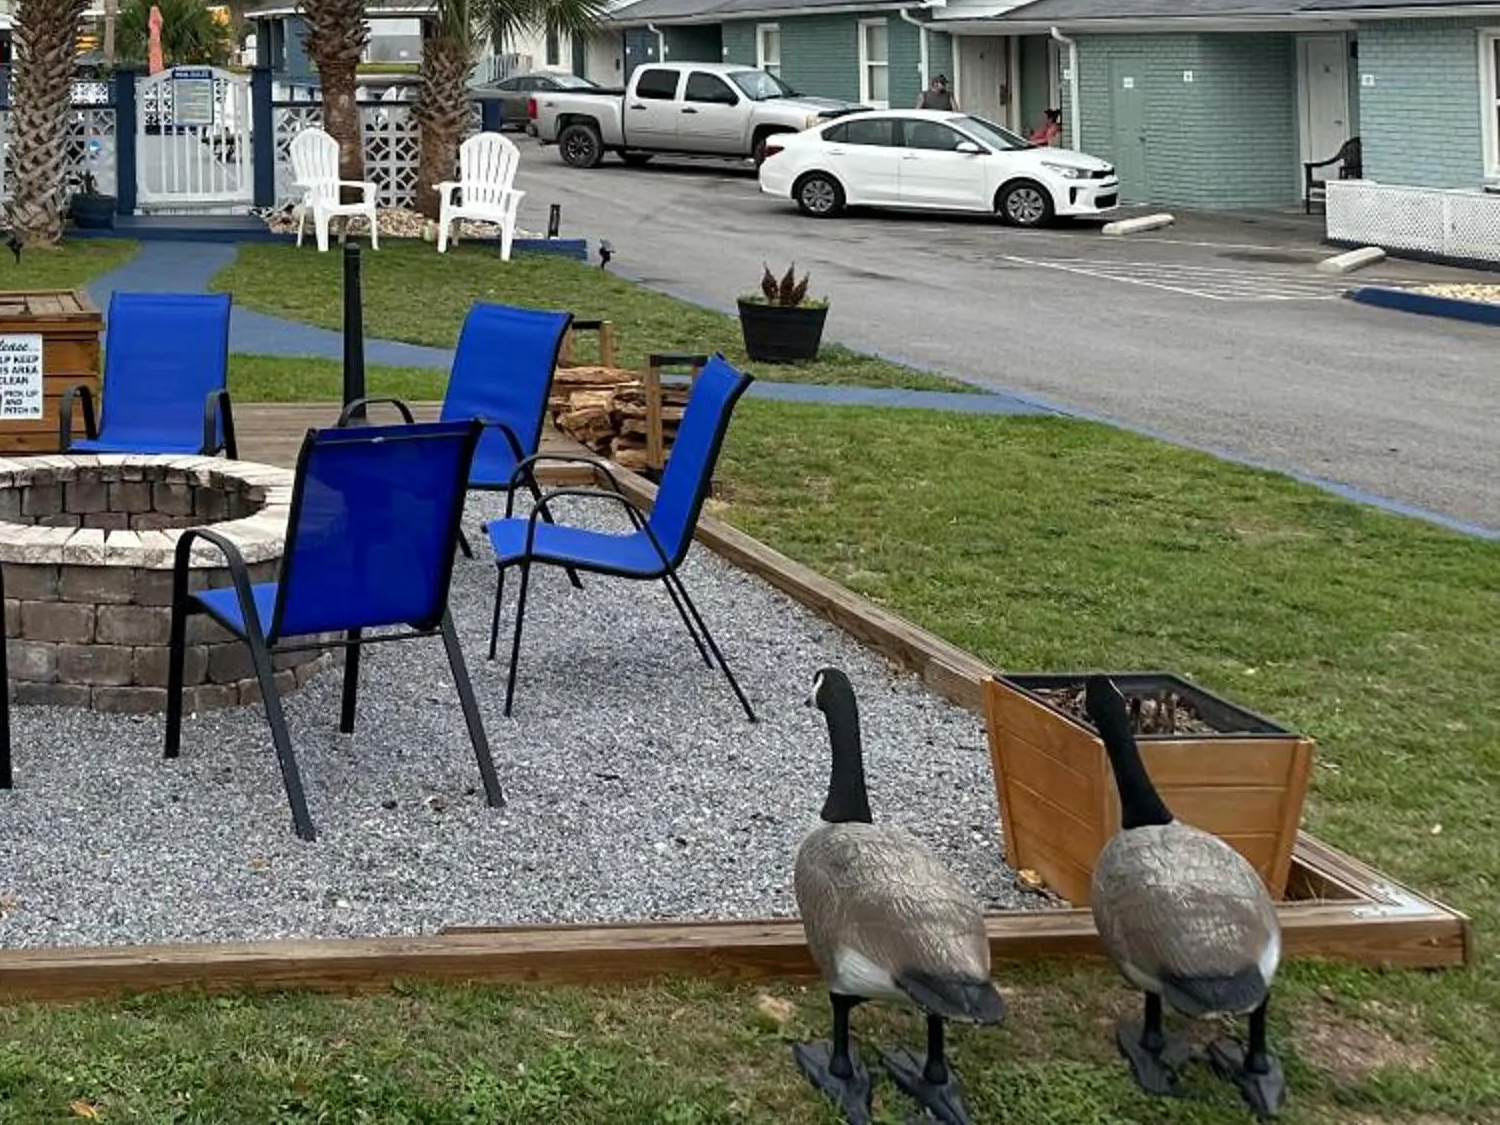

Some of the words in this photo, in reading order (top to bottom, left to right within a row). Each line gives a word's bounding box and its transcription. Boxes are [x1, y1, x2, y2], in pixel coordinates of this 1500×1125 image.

[13, 355, 39, 364] KEEP
[11, 366, 38, 374] AREA
[30, 406, 40, 414] IN
